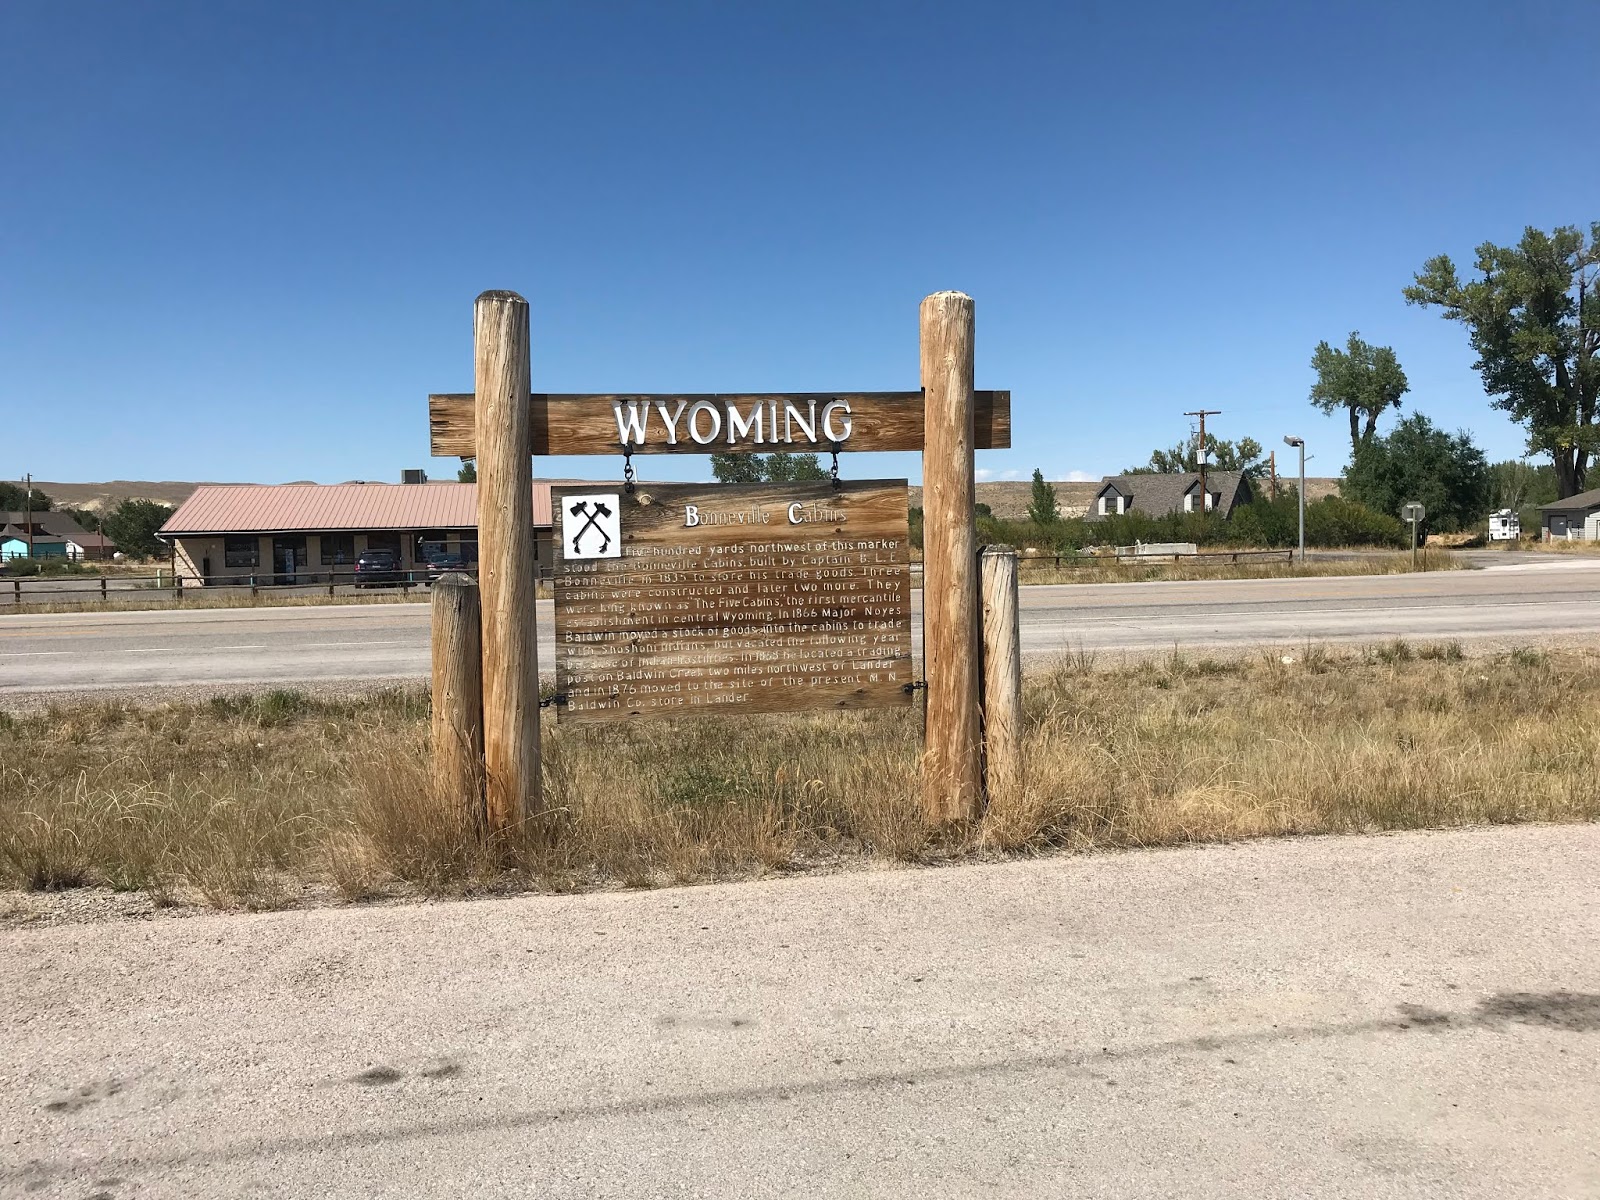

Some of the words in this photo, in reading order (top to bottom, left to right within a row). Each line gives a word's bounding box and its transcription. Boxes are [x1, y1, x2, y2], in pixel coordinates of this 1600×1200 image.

[611, 399, 852, 445] WYOMING
[684, 504, 770, 527] Bonneville
[787, 502, 847, 525] Cabins
[625, 546, 648, 556] Five
[653, 545, 701, 556] hundred
[709, 544, 744, 557] yards
[750, 542, 811, 554] northwest
[815, 541, 828, 551] of
[832, 540, 854, 551] this
[857, 539, 899, 550] marker
[563, 562, 598, 572] stood
[606, 562, 627, 571] the
[633, 559, 697, 570] Bonneville
[750, 555, 775, 566] built
[782, 556, 795, 567] by
[802, 554, 850, 566] Captain
[859, 553, 870, 563] B.
[875, 553, 886, 562] L.
[564, 574, 634, 586] Bonneville
[641, 574, 652, 584] in
[693, 572, 704, 582] to
[711, 571, 743, 581] store
[750, 570, 767, 580] his
[775, 569, 809, 579] trade
[863, 567, 900, 576] Three
[565, 591, 605, 600] cabins
[611, 590, 641, 598] were
[648, 585, 722, 597] constructed
[728, 584, 749, 595] and
[757, 582, 788, 593] later
[794, 582, 818, 592] two
[823, 581, 859, 591] more.
[867, 579, 901, 591] They
[566, 605, 595, 614] were
[600, 603, 625, 614] long
[630, 602, 672, 612] known
[676, 601, 689, 609] as
[718, 596, 741, 608] Five
[786, 595, 804, 606] the
[808, 594, 836, 605] first
[839, 592, 901, 603] mercantile
[658, 613, 669, 624] in
[673, 611, 719, 623] central
[722, 610, 776, 624] Wyoming.
[778, 609, 789, 619] In
[792, 608, 818, 619] 1866
[821, 607, 856, 619] Major
[864, 606, 901, 617] Noyes
[565, 629, 615, 642] Baldwin
[619, 628, 658, 640] moved
[661, 631, 668, 639] a
[672, 626, 704, 638] stock
[707, 626, 719, 636] of
[762, 622, 785, 634] into
[788, 622, 807, 633] the
[811, 620, 848, 632] cabins
[853, 619, 864, 630] to
[868, 618, 902, 630] trade
[567, 644, 594, 656] with
[601, 642, 657, 655] Shoshoni
[714, 638, 733, 649] but
[737, 636, 783, 648] vacated
[787, 635, 805, 646] the
[810, 633, 866, 646] following
[873, 632, 901, 645] year
[621, 656, 633, 667] of
[638, 655, 676, 667] Indian
[741, 652, 752, 661] In
[783, 649, 796, 660] he
[799, 647, 843, 659] located
[847, 648, 853, 657] a
[856, 645, 901, 658] trading
[567, 674, 594, 685] post
[598, 672, 613, 682] on
[617, 669, 665, 682] Baldwin
[669, 667, 703, 679] Creek
[708, 666, 730, 677] two
[733, 663, 763, 675] miles
[767, 661, 827, 674] northwest
[832, 659, 845, 670] of
[852, 658, 895, 670] Lander
[567, 686, 590, 698] and
[593, 685, 605, 696] in
[608, 683, 637, 695] 1876
[640, 681, 681, 693] moved
[687, 680, 699, 691] to
[704, 679, 723, 690] the
[729, 678, 754, 689] site
[760, 677, 774, 687] of
[783, 675, 804, 686] the
[811, 673, 861, 687] present
[869, 673, 882, 682] M.
[568, 698, 620, 711] Baldwin
[626, 697, 645, 709] Co.
[651, 696, 684, 707] store
[690, 694, 700, 705] in
[706, 691, 753, 704] Lander.
